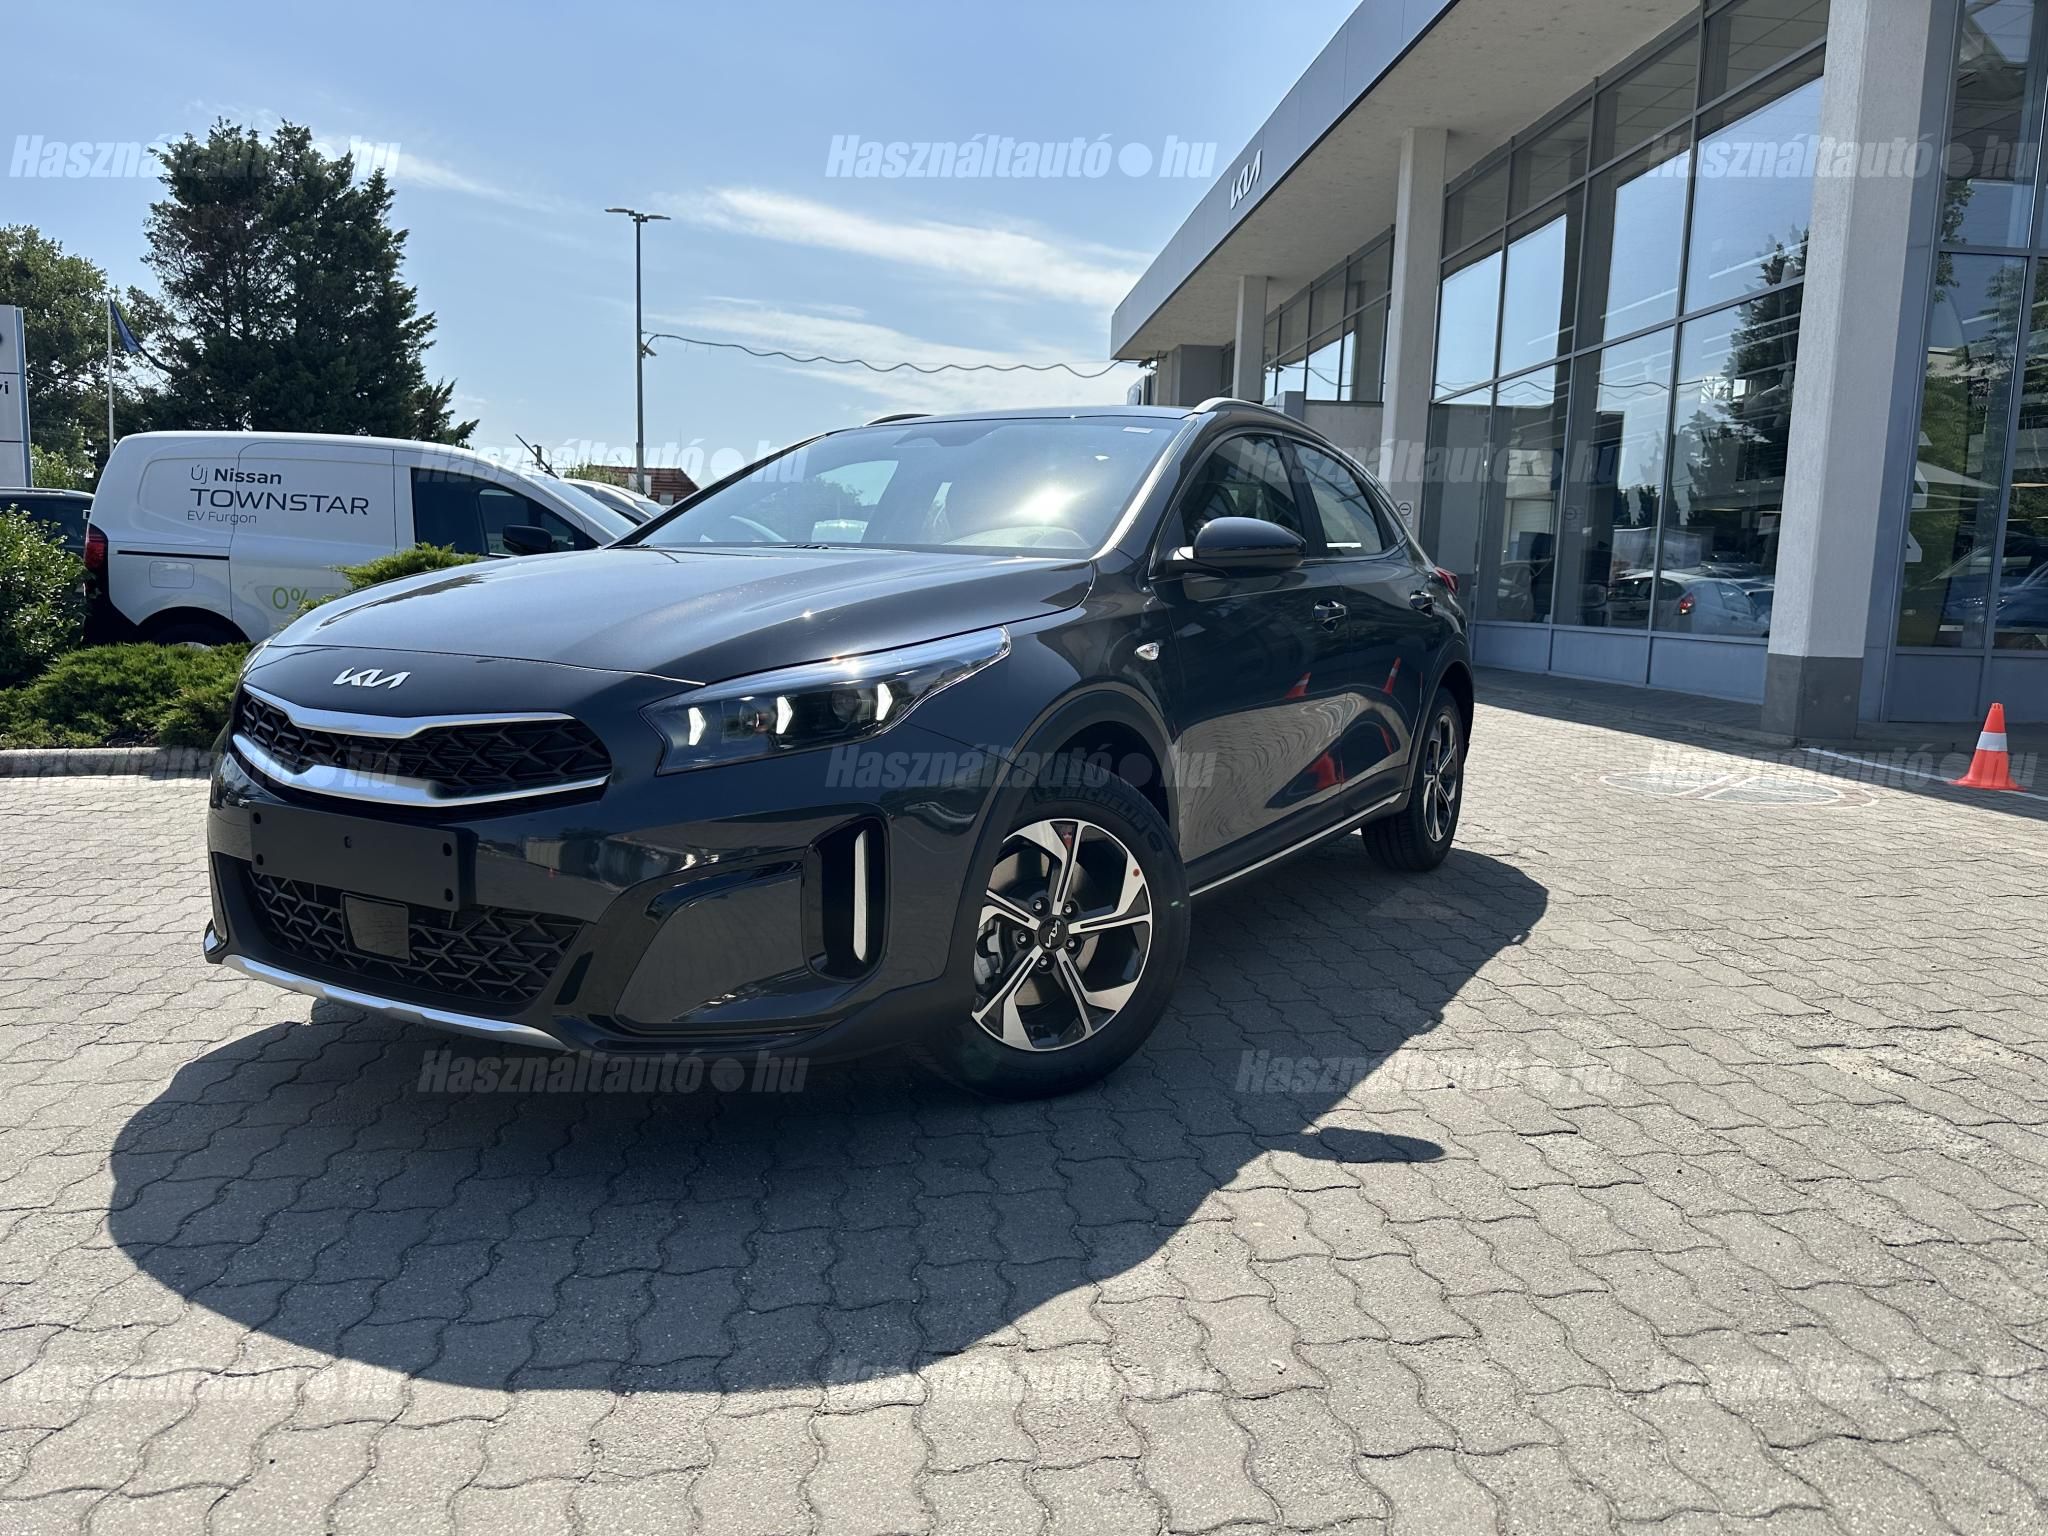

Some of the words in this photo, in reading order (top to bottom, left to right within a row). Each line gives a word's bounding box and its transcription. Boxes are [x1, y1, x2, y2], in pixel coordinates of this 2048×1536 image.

[190, 464, 208, 484] Új
[214, 468, 282, 485] Nissan
[189, 488, 370, 516] TOWNSTAR
[187, 510, 205, 521] EV
[208, 511, 257, 525] Furgon
